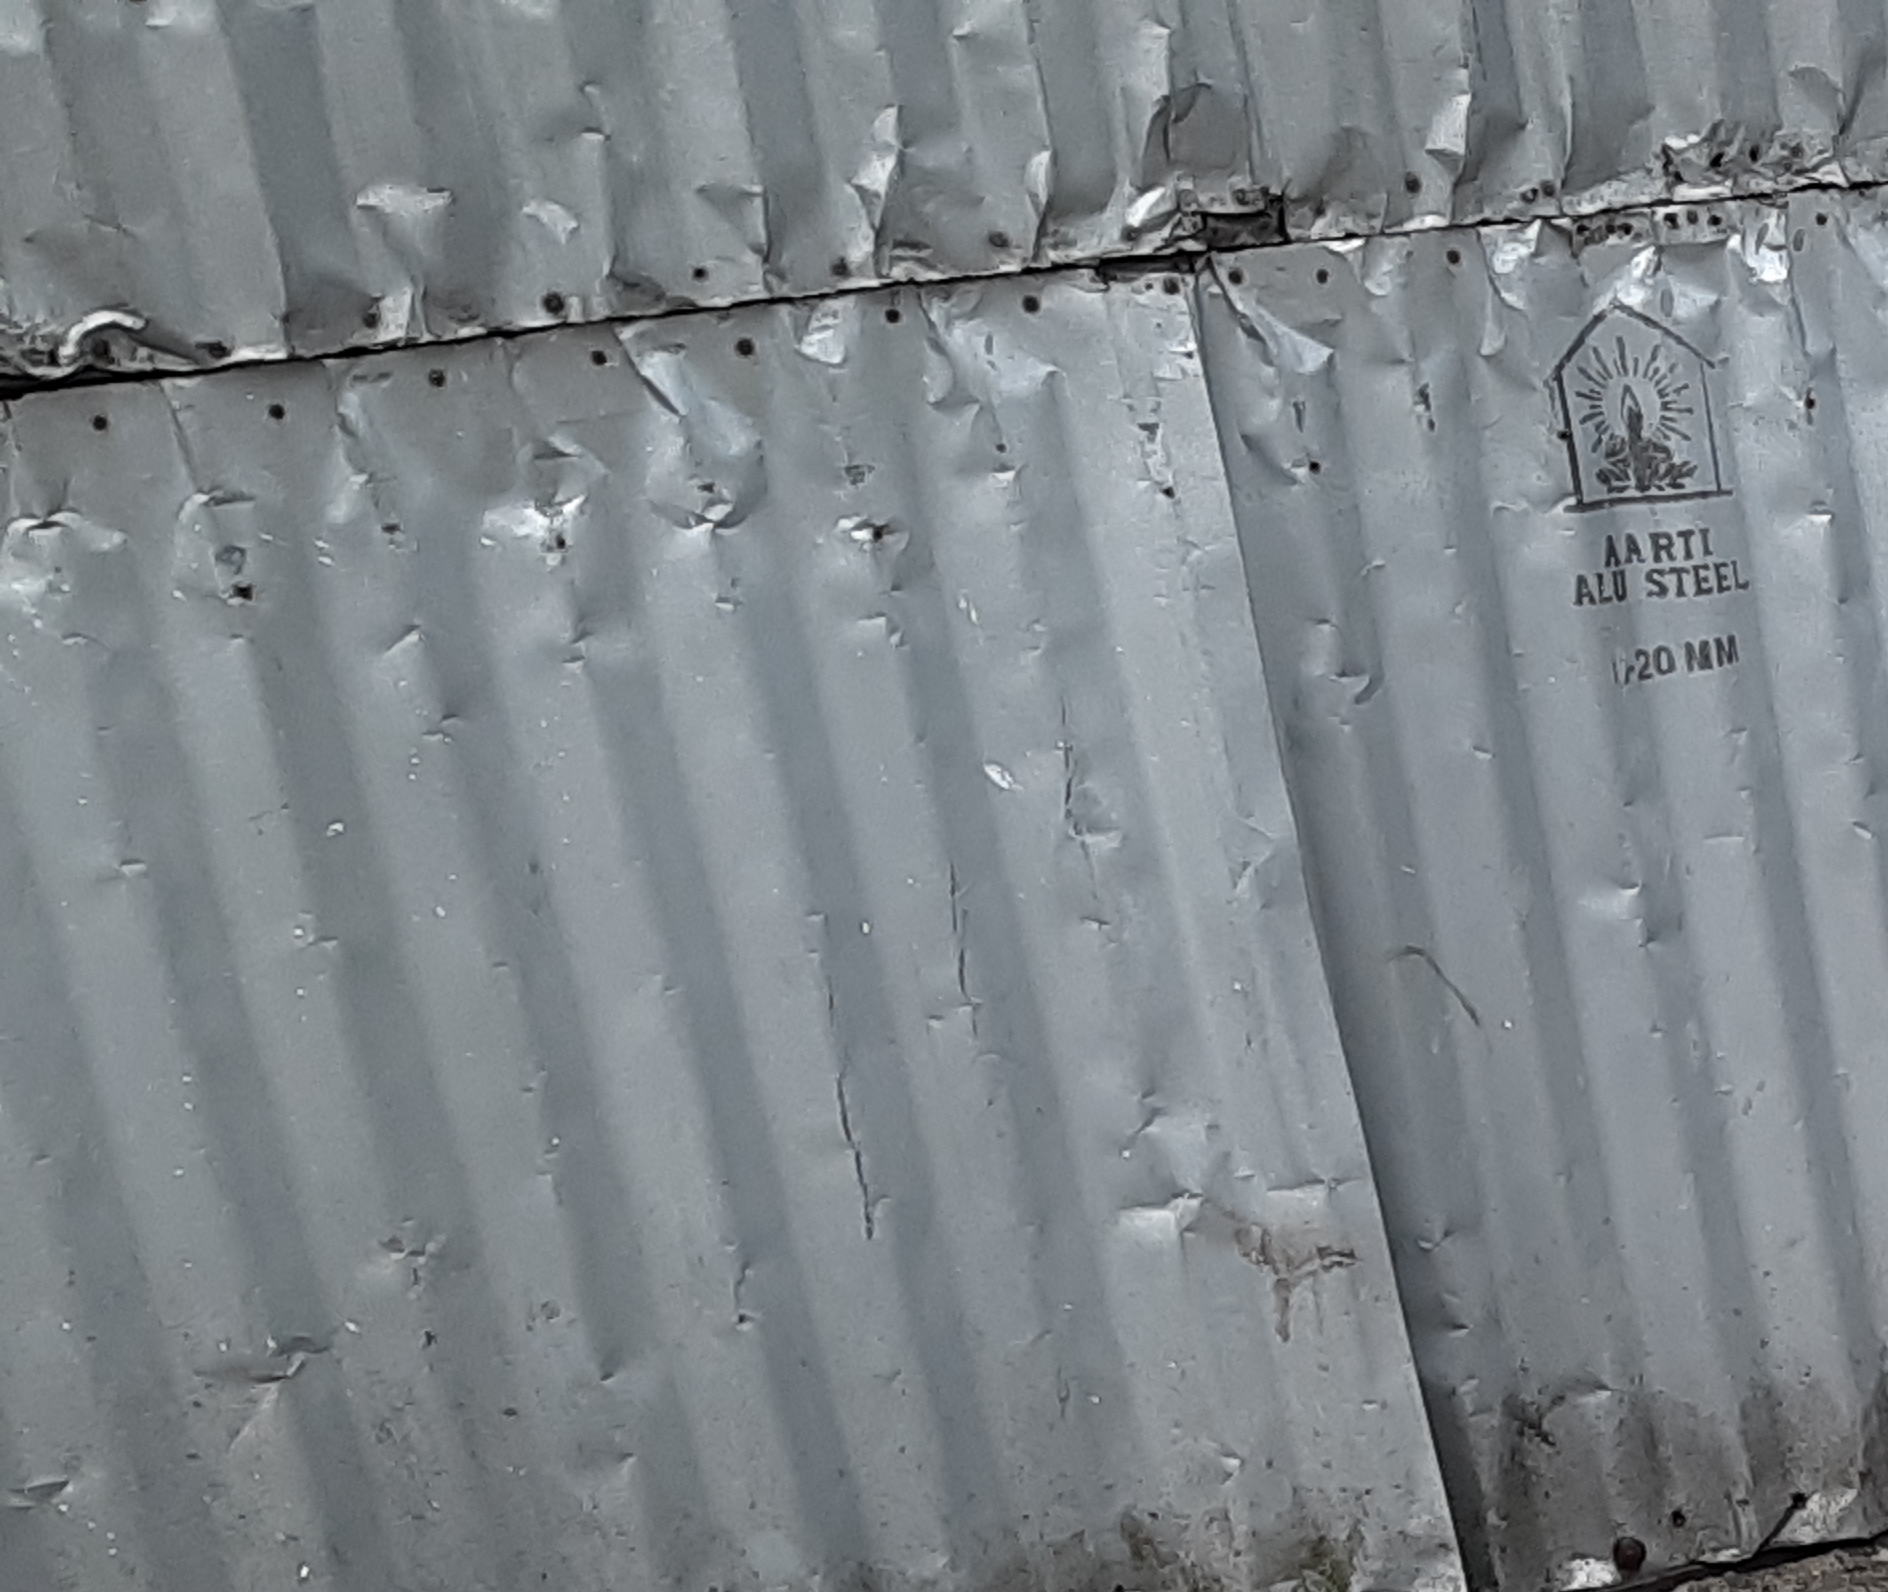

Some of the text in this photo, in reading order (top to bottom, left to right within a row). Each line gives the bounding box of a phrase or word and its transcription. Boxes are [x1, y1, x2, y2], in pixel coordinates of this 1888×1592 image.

[1604, 528, 1713, 567] AARTI
[1573, 560, 1750, 606] ALU STEEL
[1684, 634, 1739, 672] MM
